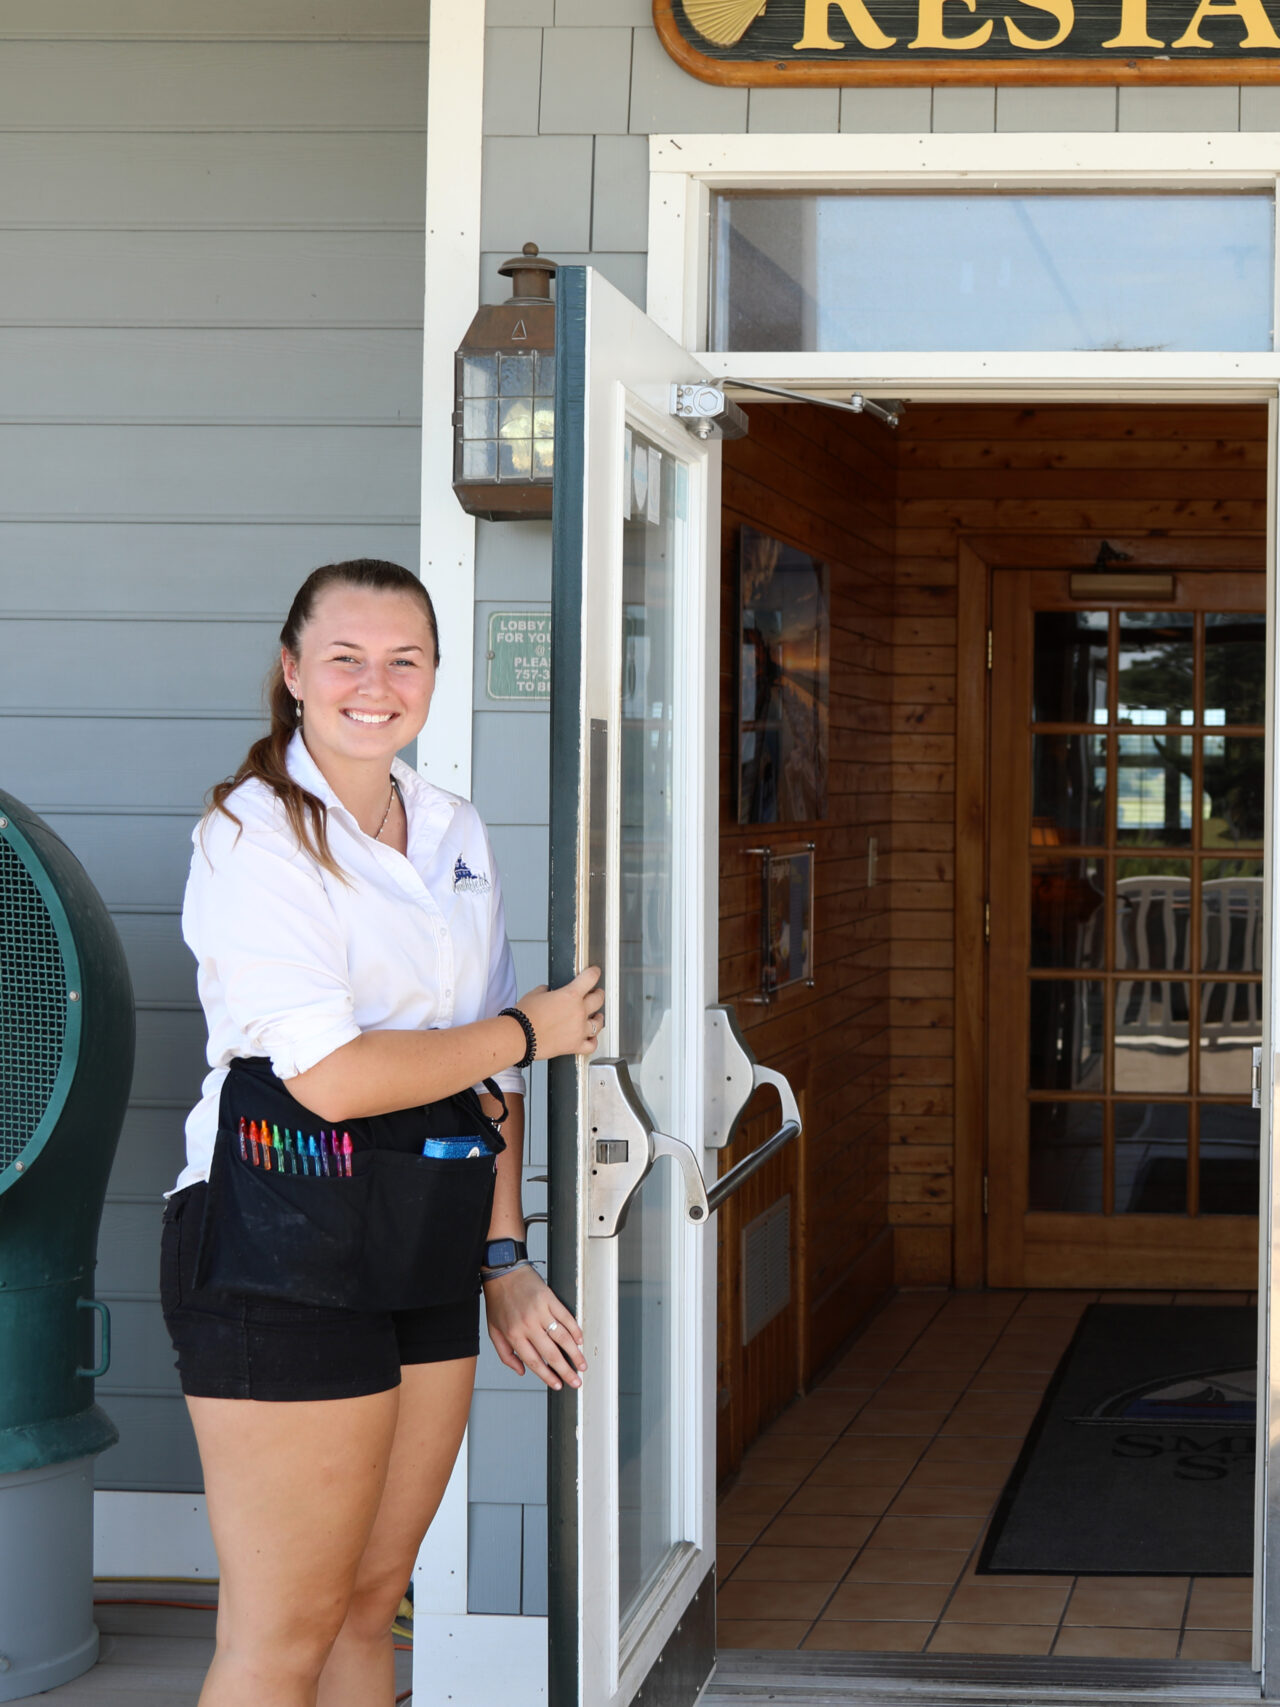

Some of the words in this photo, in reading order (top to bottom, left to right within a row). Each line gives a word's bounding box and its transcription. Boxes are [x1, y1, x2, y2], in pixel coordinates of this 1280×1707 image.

[500, 620, 546, 631] LOBBY
[496, 632, 524, 643] FOR
[535, 645, 545, 656] @
[514, 657, 551, 667] PLEA
[516, 681, 535, 692] TO
